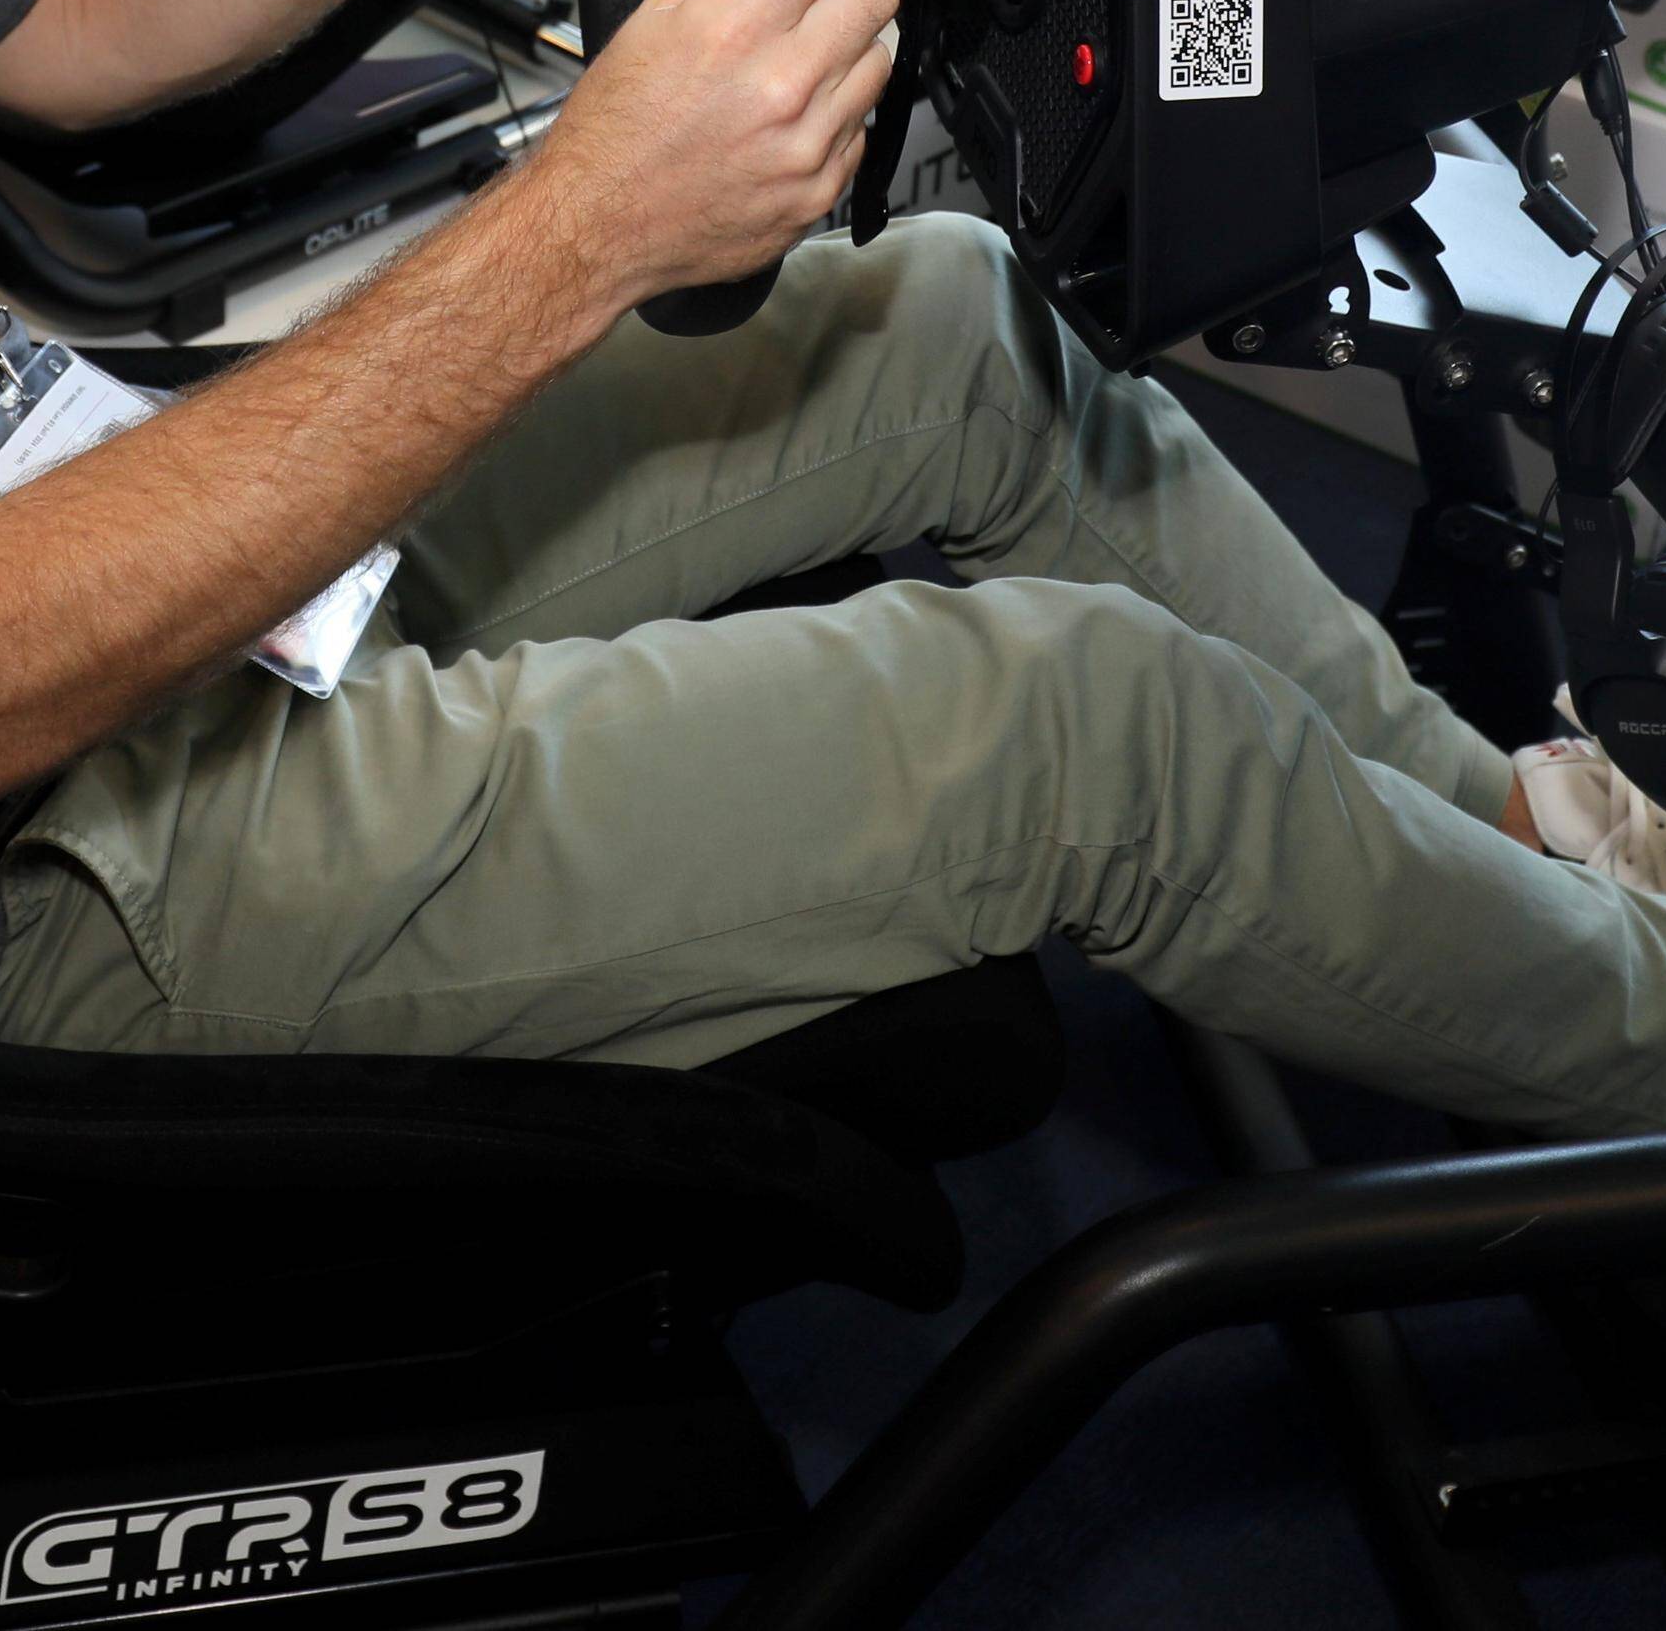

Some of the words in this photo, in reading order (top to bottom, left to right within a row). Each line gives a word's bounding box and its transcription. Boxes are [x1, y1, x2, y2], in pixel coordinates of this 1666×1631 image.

[21, 1495, 314, 1587] GTR
[341, 1469, 523, 1546] S8
[116, 1558, 310, 1603] INFINITY
